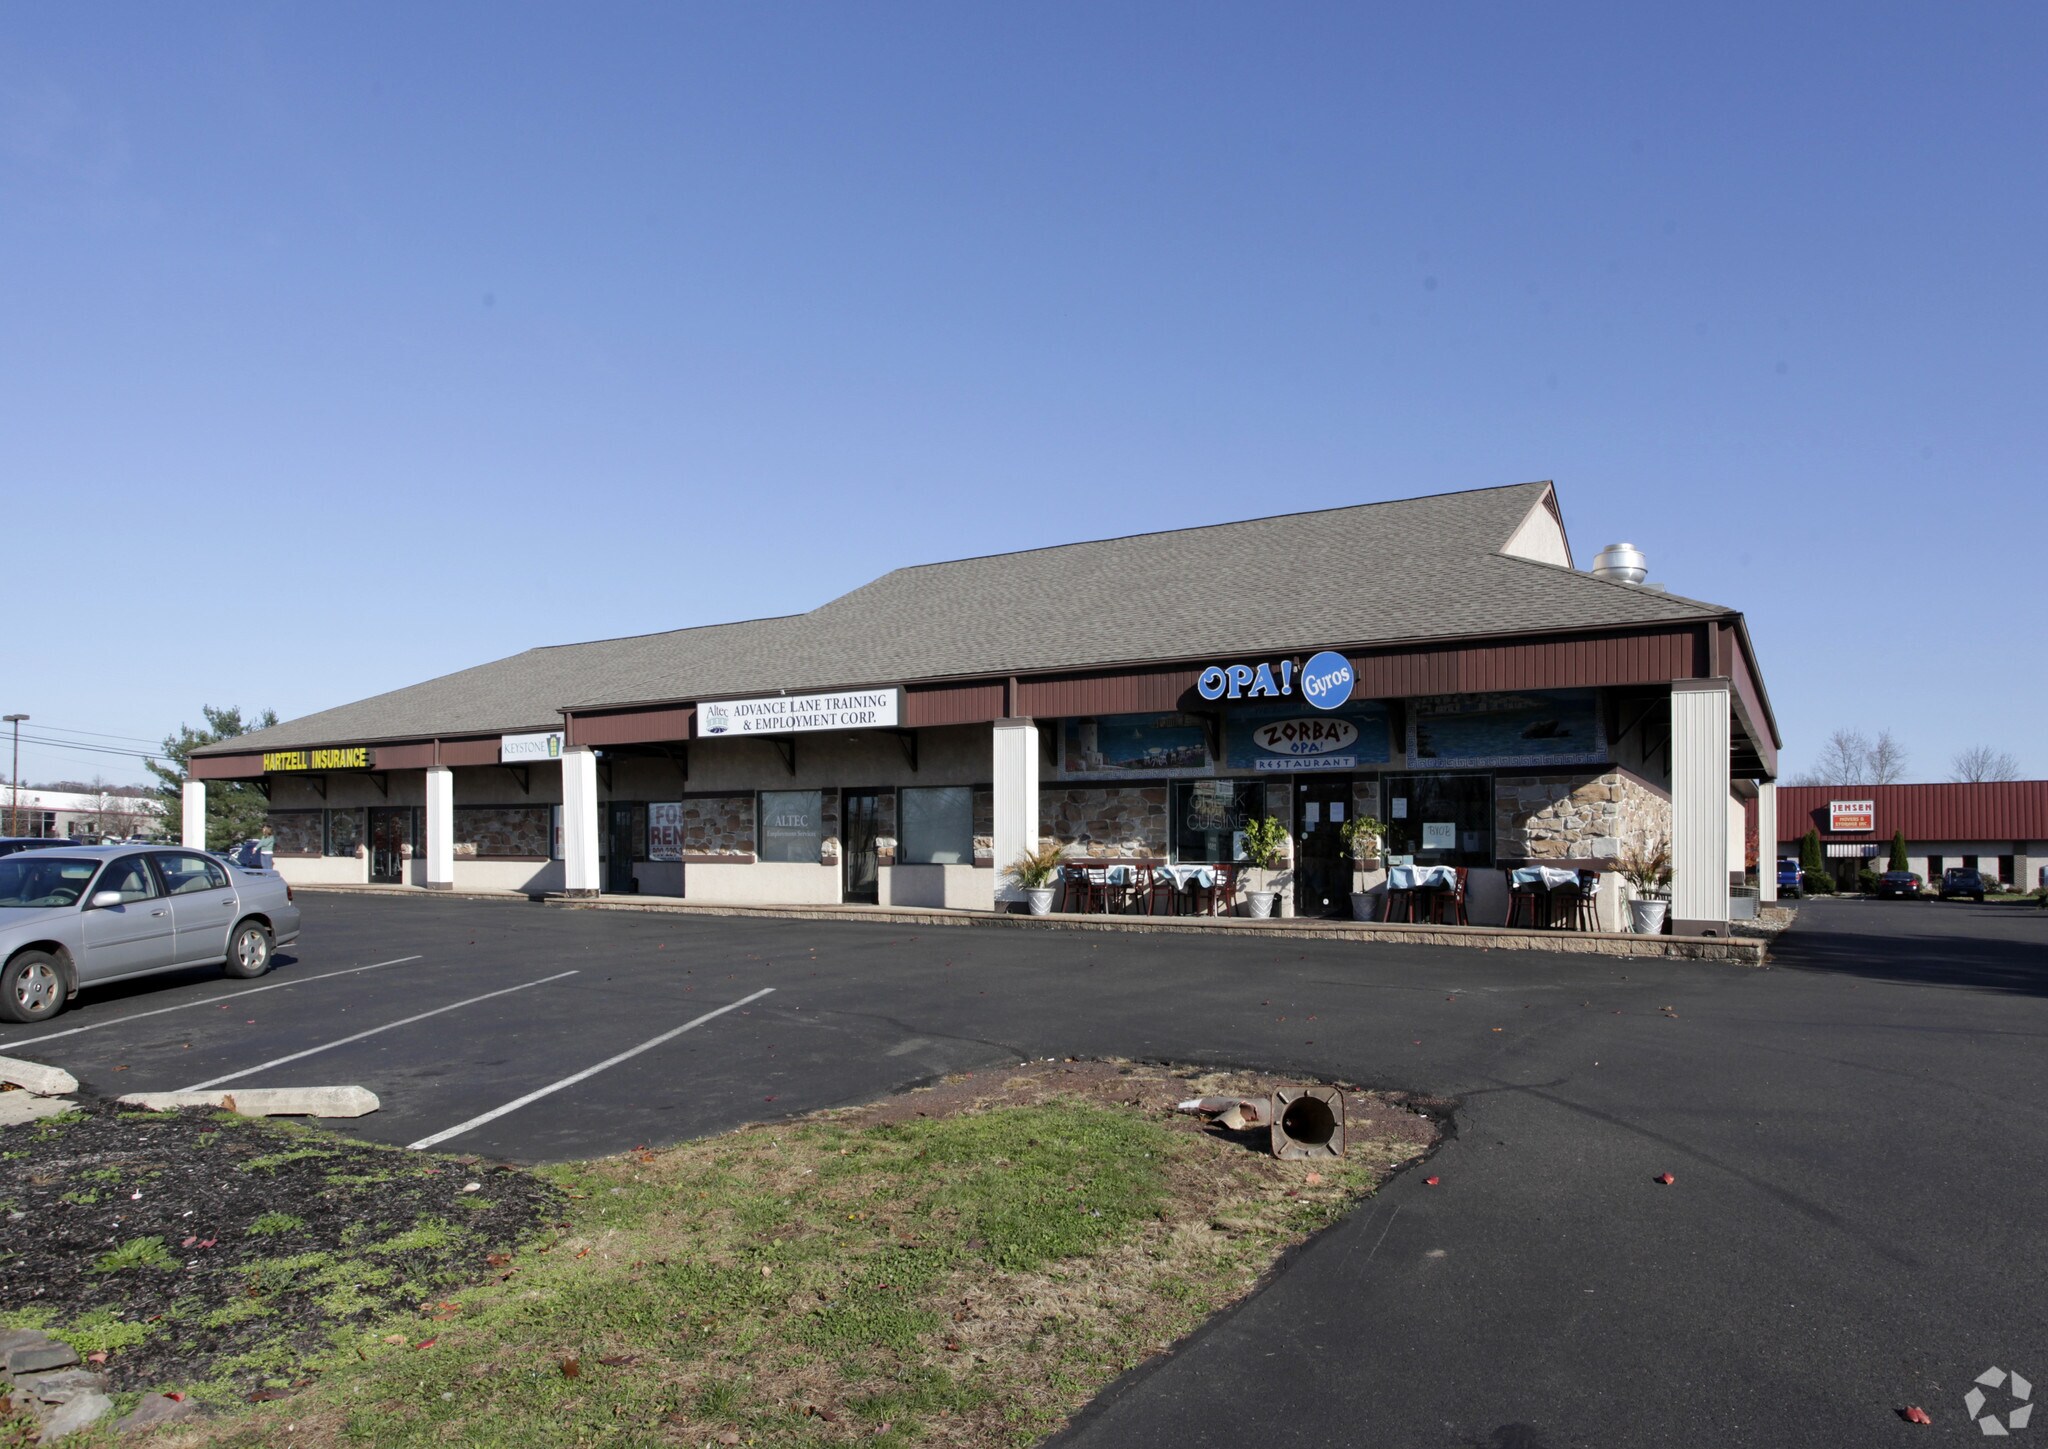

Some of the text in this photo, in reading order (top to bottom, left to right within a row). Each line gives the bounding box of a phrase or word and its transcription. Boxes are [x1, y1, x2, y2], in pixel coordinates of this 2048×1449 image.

[1197, 660, 1293, 700] OPA!
[1305, 666, 1350, 697] Gyros
[706, 704, 729, 719] Altec
[733, 694, 887, 717] ADVANCE LANE TRAINING
[743, 711, 877, 731] & EMPLOYMENT CORP.
[504, 741, 545, 754] KEYSTONE
[1290, 742, 1324, 754] OPA!
[263, 748, 367, 771] HARTZELL INSURANCE
[1259, 758, 1350, 769] RESTAURANT
[1832, 803, 1872, 813] JENSEN
[775, 814, 809, 827] ALTEC
[1186, 813, 1249, 831] CUISINE
